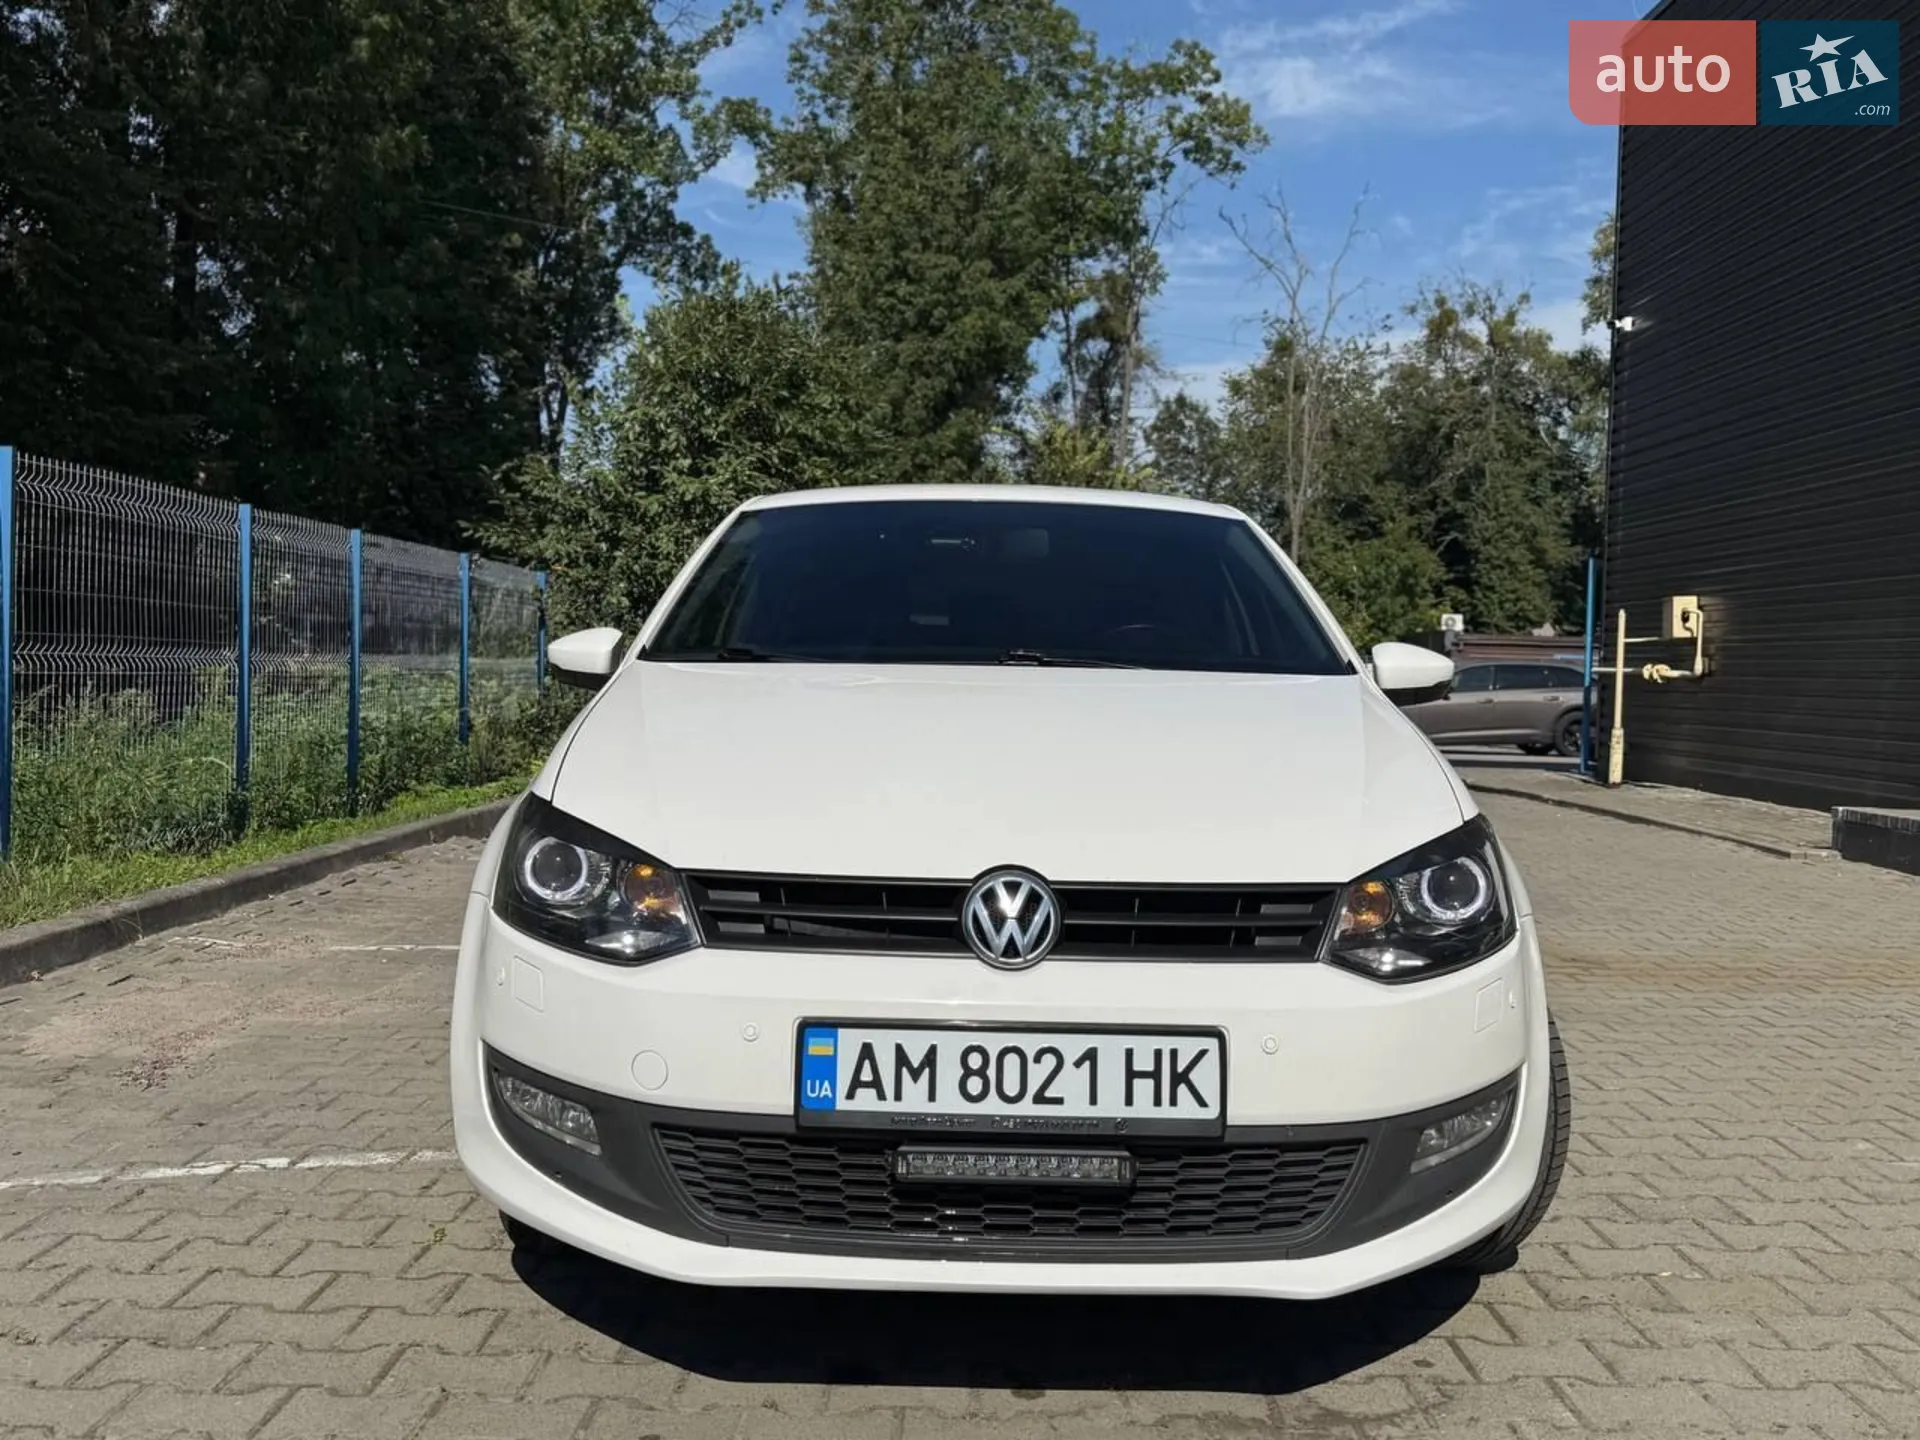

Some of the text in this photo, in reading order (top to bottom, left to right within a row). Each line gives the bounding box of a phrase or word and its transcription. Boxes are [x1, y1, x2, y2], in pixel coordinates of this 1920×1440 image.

[806, 1079, 833, 1099] UA
[845, 1041, 1210, 1109] AM 8021 HK
